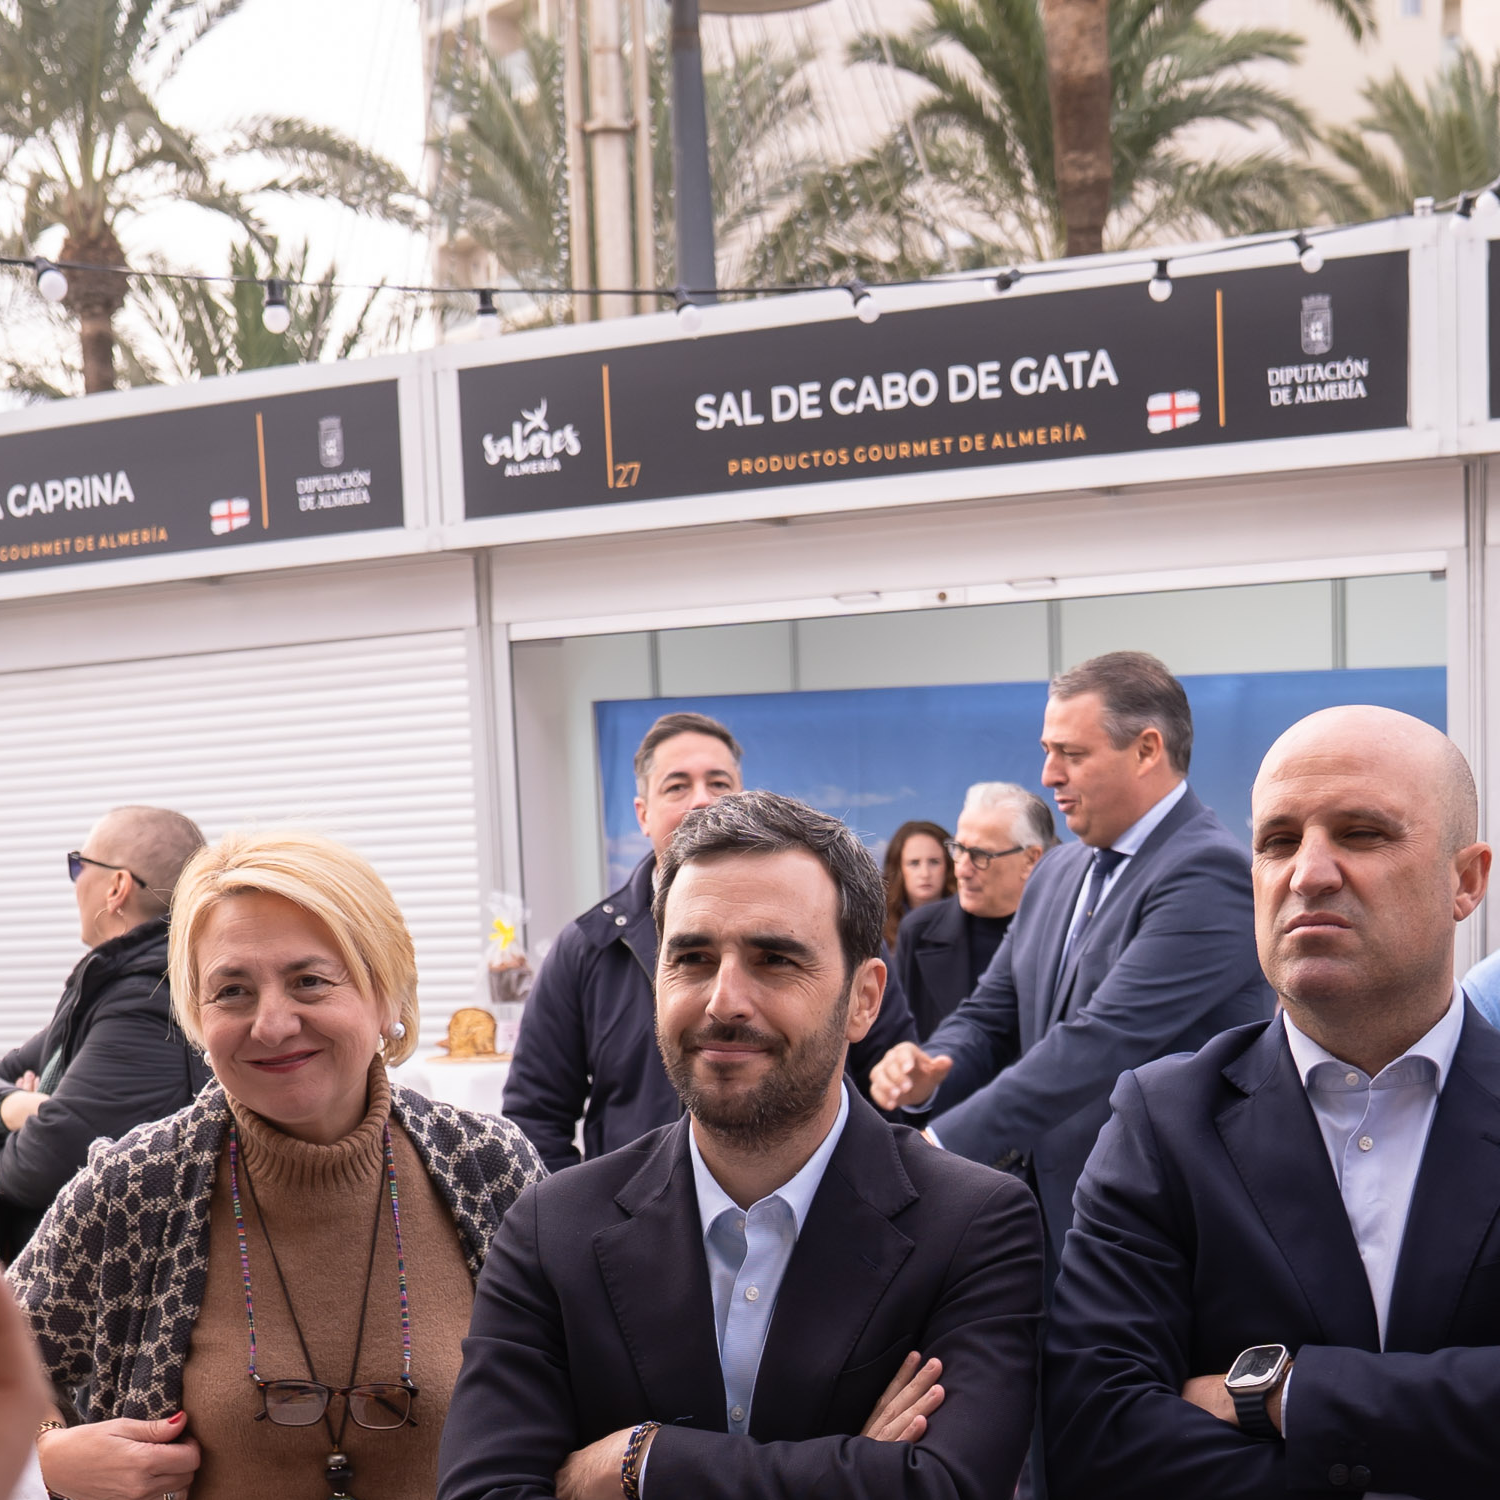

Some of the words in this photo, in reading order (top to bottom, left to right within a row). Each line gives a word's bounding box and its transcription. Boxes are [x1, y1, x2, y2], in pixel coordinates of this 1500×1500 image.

[694, 389, 765, 431] SAL
[770, 381, 823, 423] DE
[828, 368, 939, 415] CABO
[947, 360, 1002, 403] DE
[1009, 348, 1119, 396] GATA
[1267, 356, 1369, 386] DIPUTACIÓN
[1269, 387, 1294, 406] DE
[1294, 378, 1368, 405] ALMERÍA
[727, 447, 850, 477] PRODUCTOS
[853, 436, 954, 464] GOURMET
[959, 432, 987, 453] DE
[991, 421, 1088, 450] ALMERÍA
[6, 469, 135, 519] CAPRINA
[614, 461, 642, 488] 27
[0, 538, 71, 563] GOURMET
[74, 534, 96, 553] DE
[98, 523, 169, 550] ALMERÍA
